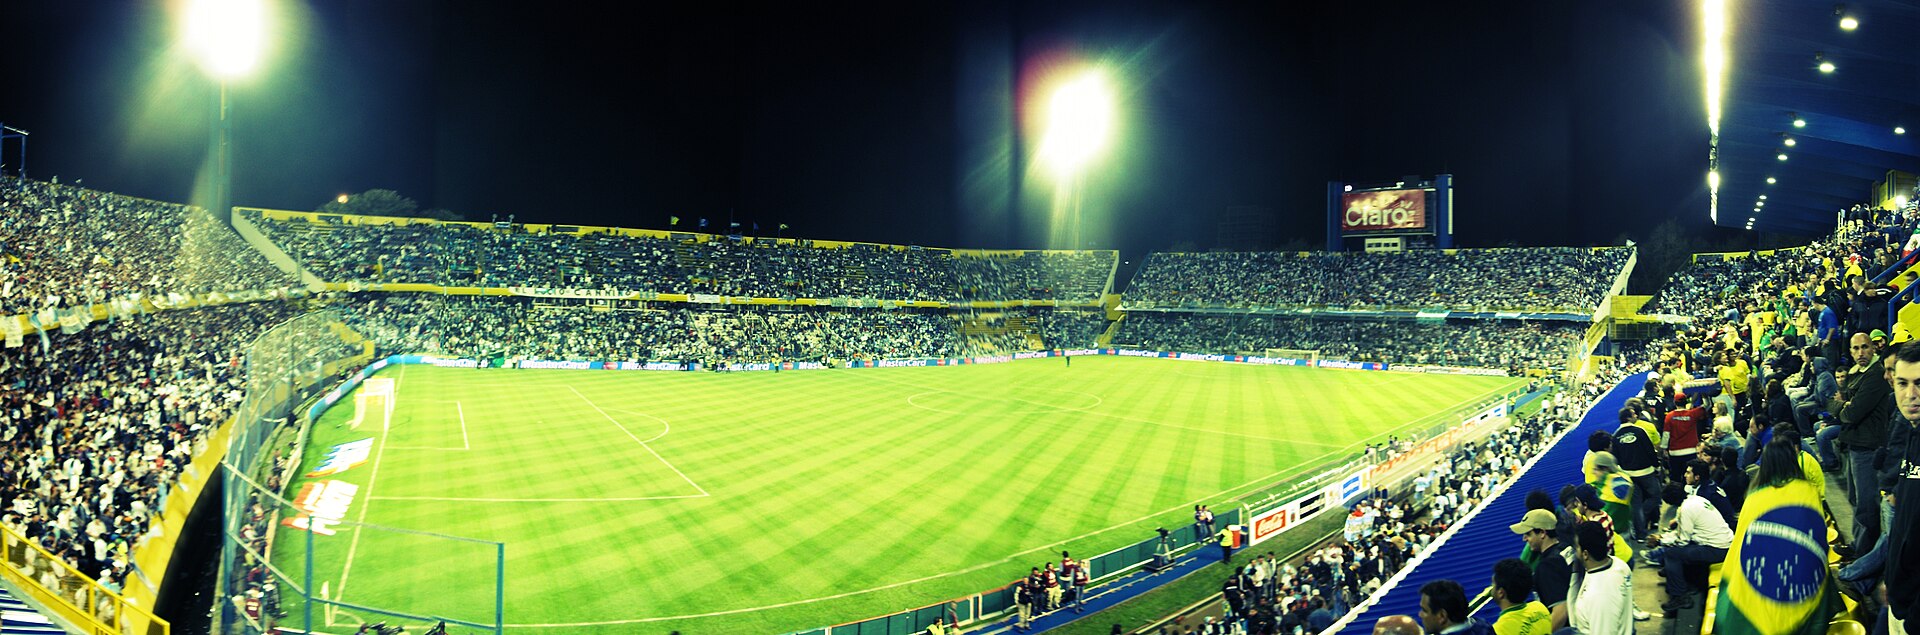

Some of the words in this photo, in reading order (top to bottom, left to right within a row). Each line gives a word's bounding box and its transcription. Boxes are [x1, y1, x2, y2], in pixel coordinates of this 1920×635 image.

[1346, 207, 1408, 226] Claro
[1118, 349, 1160, 357] MasterCard
[1180, 353, 1225, 361] MasterCard
[878, 359, 926, 367] MasterCard
[1247, 356, 1296, 366] MasterCard
